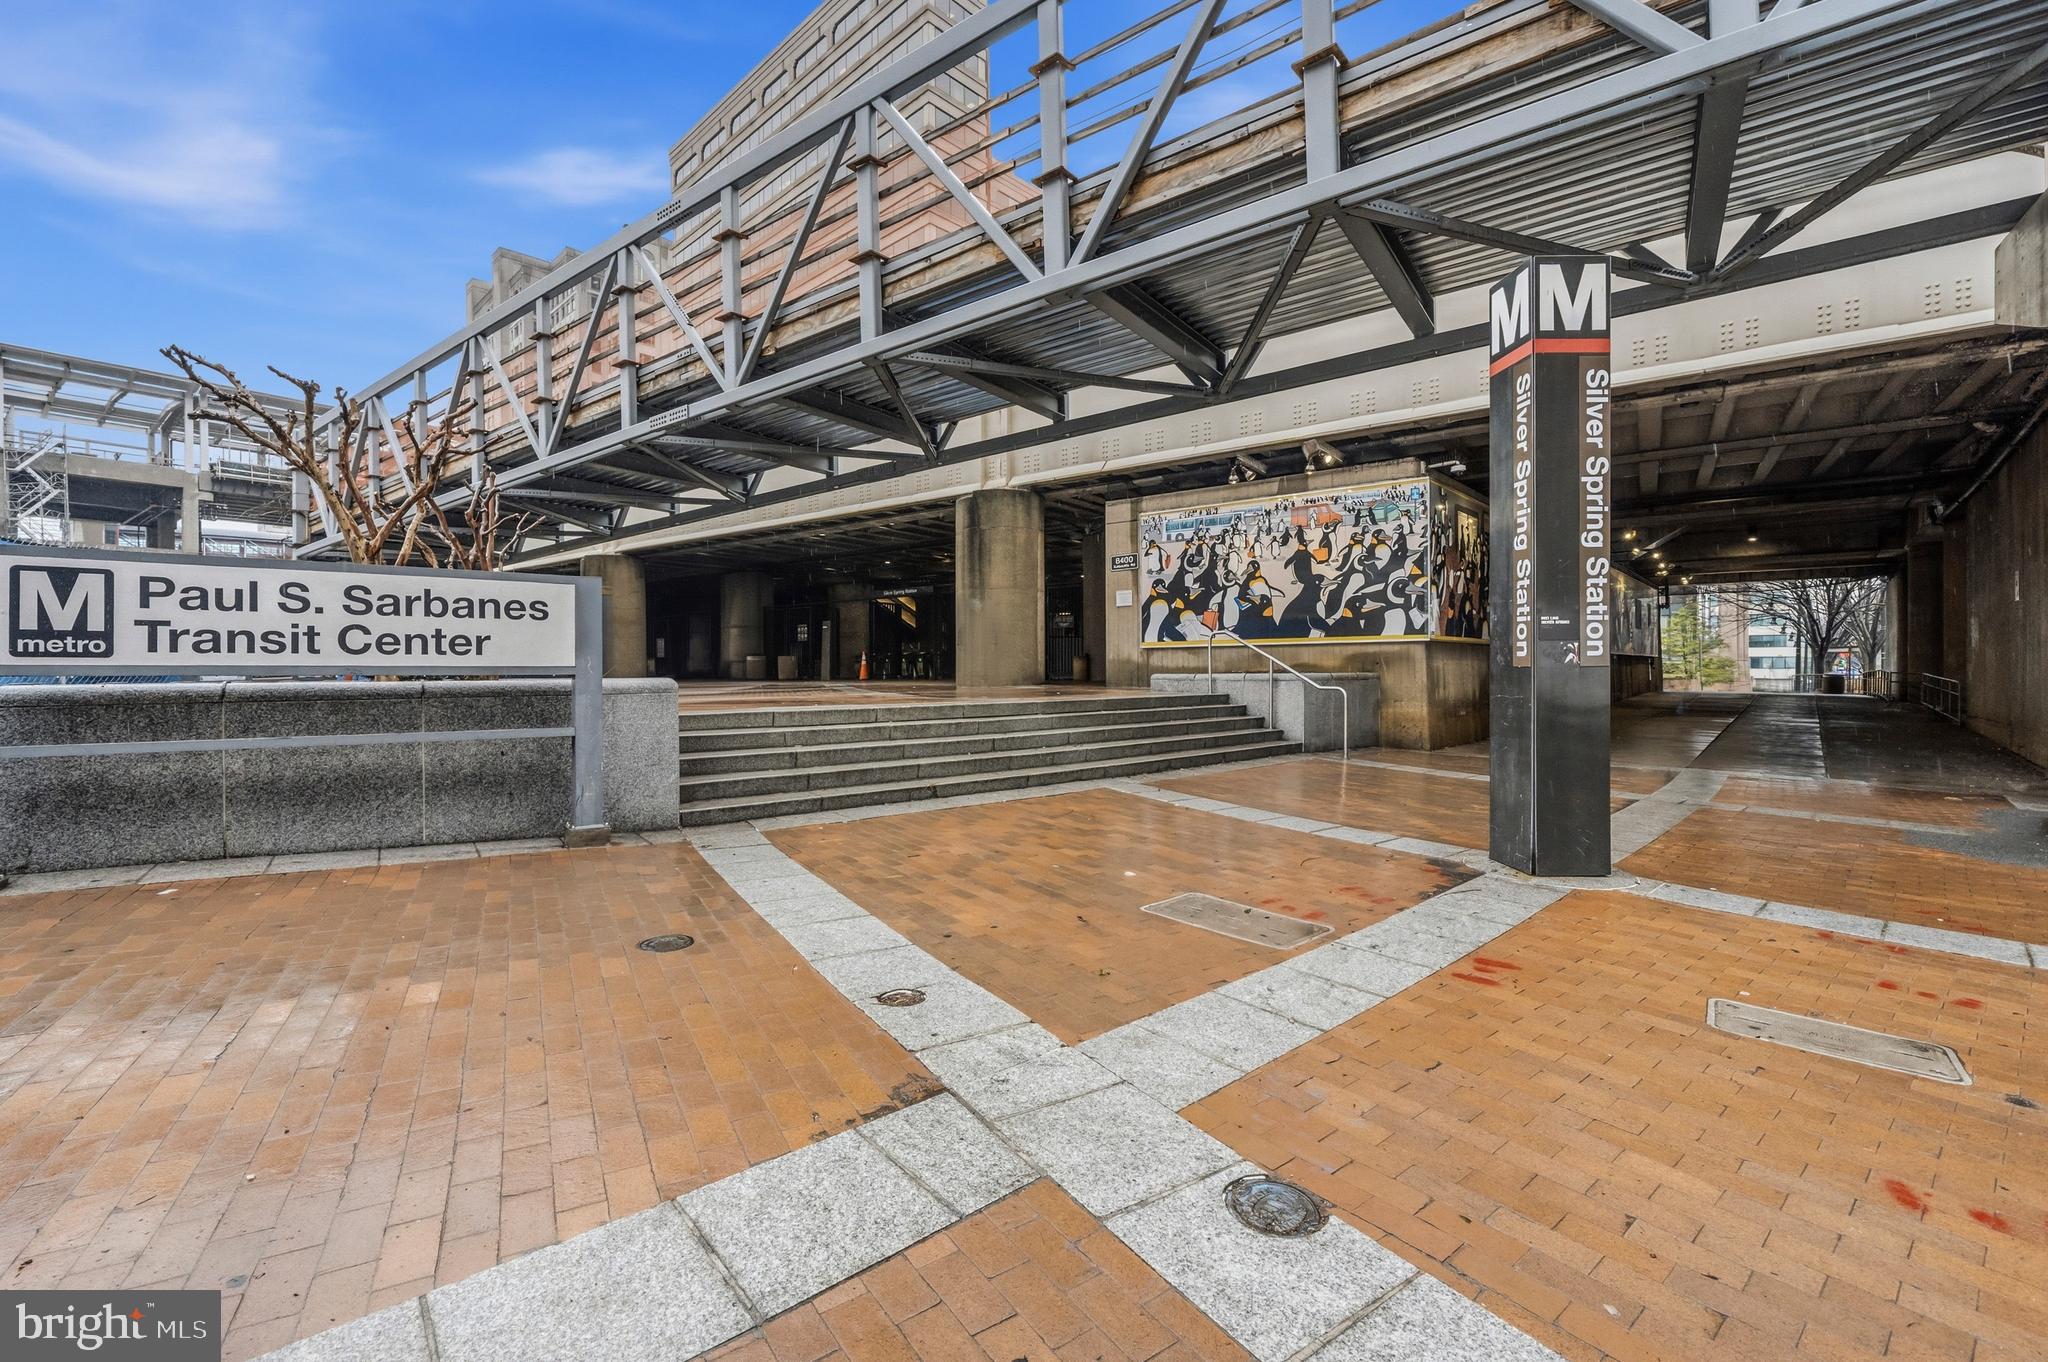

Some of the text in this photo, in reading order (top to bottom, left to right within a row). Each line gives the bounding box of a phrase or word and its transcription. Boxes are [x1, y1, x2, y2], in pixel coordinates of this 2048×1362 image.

[1491, 267, 1530, 356] M
[1540, 263, 1607, 331] M
[1513, 372, 1531, 657] Silver Spring Station
[1581, 368, 1609, 657] Silver Spring Station
[18, 570, 105, 632] M
[138, 576, 550, 621] Paul S. Sarbanes
[17, 637, 107, 654] metro
[134, 620, 492, 657] Transit Center
